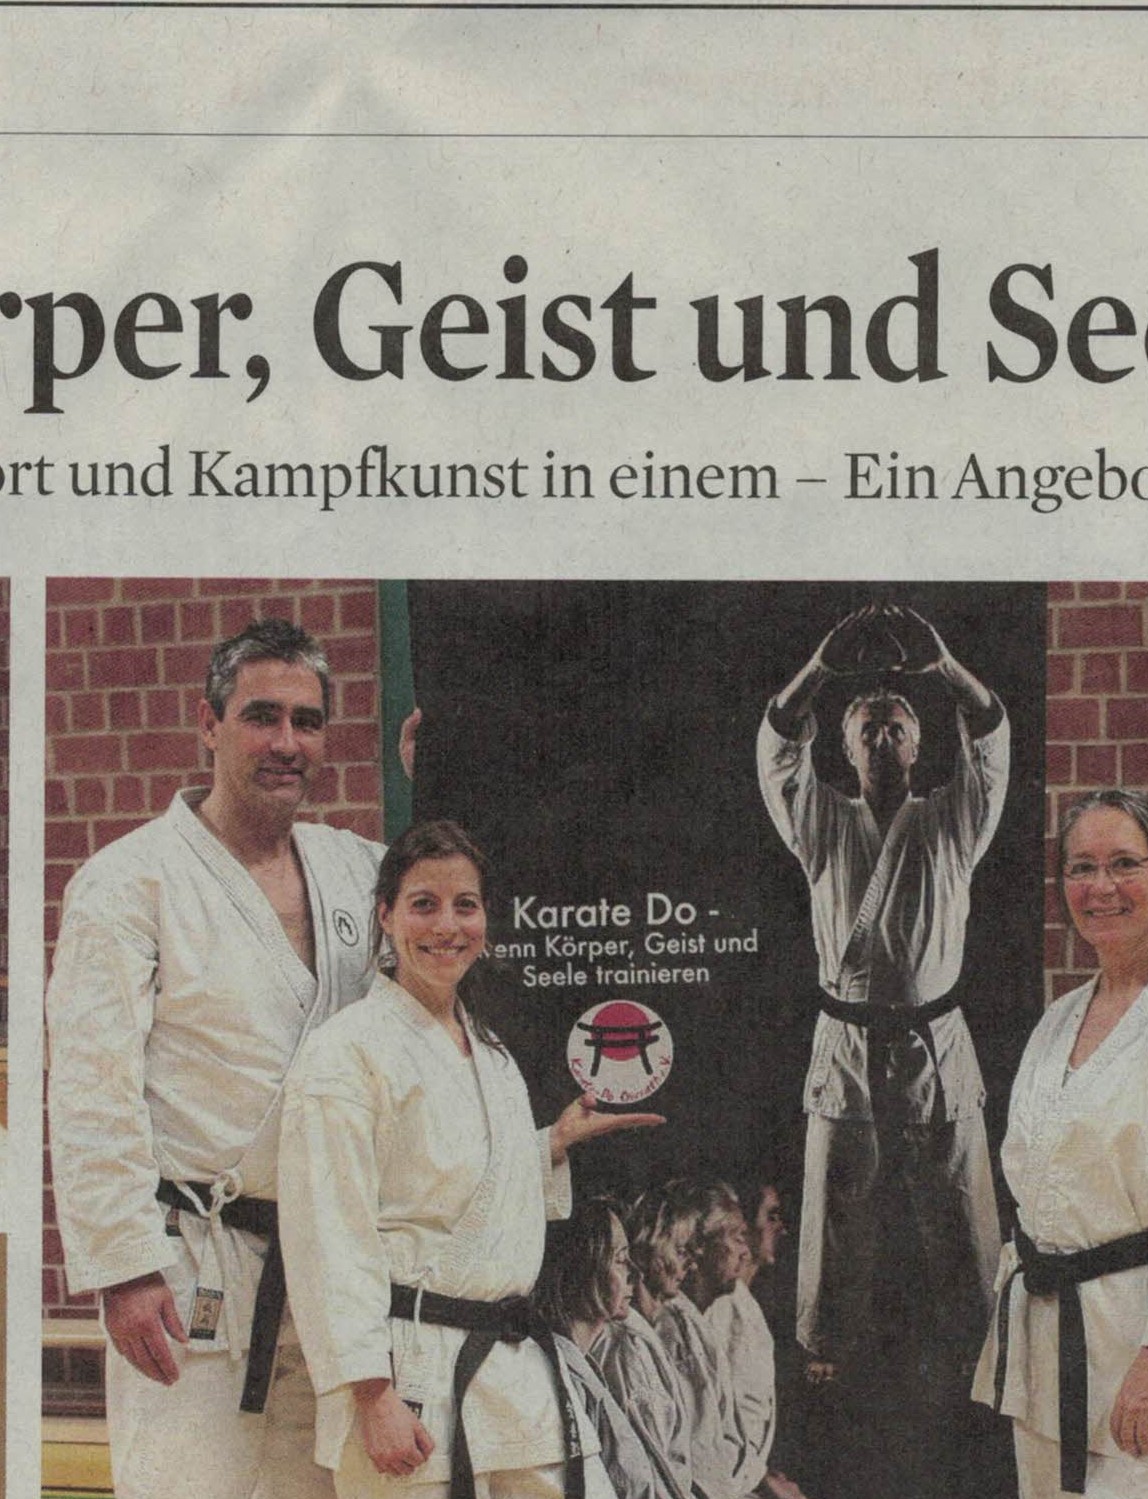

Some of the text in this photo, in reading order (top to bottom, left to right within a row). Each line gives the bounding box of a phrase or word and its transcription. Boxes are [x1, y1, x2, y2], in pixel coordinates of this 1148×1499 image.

[313, 255, 657, 382] Geist
[689, 247, 948, 383] und
[0, 455, 55, 496] rt
[68, 444, 173, 497] und
[188, 445, 529, 511] Kampfkunst
[543, 450, 595, 498] in
[610, 450, 780, 499] einem
[844, 451, 939, 499] Ein
[513, 896, 631, 929] Karate
[647, 893, 696, 926] Do
[545, 935, 635, 962] Körper,
[645, 934, 706, 955] Geist
[714, 927, 759, 953] und
[523, 962, 710, 988] Seele trainieren
